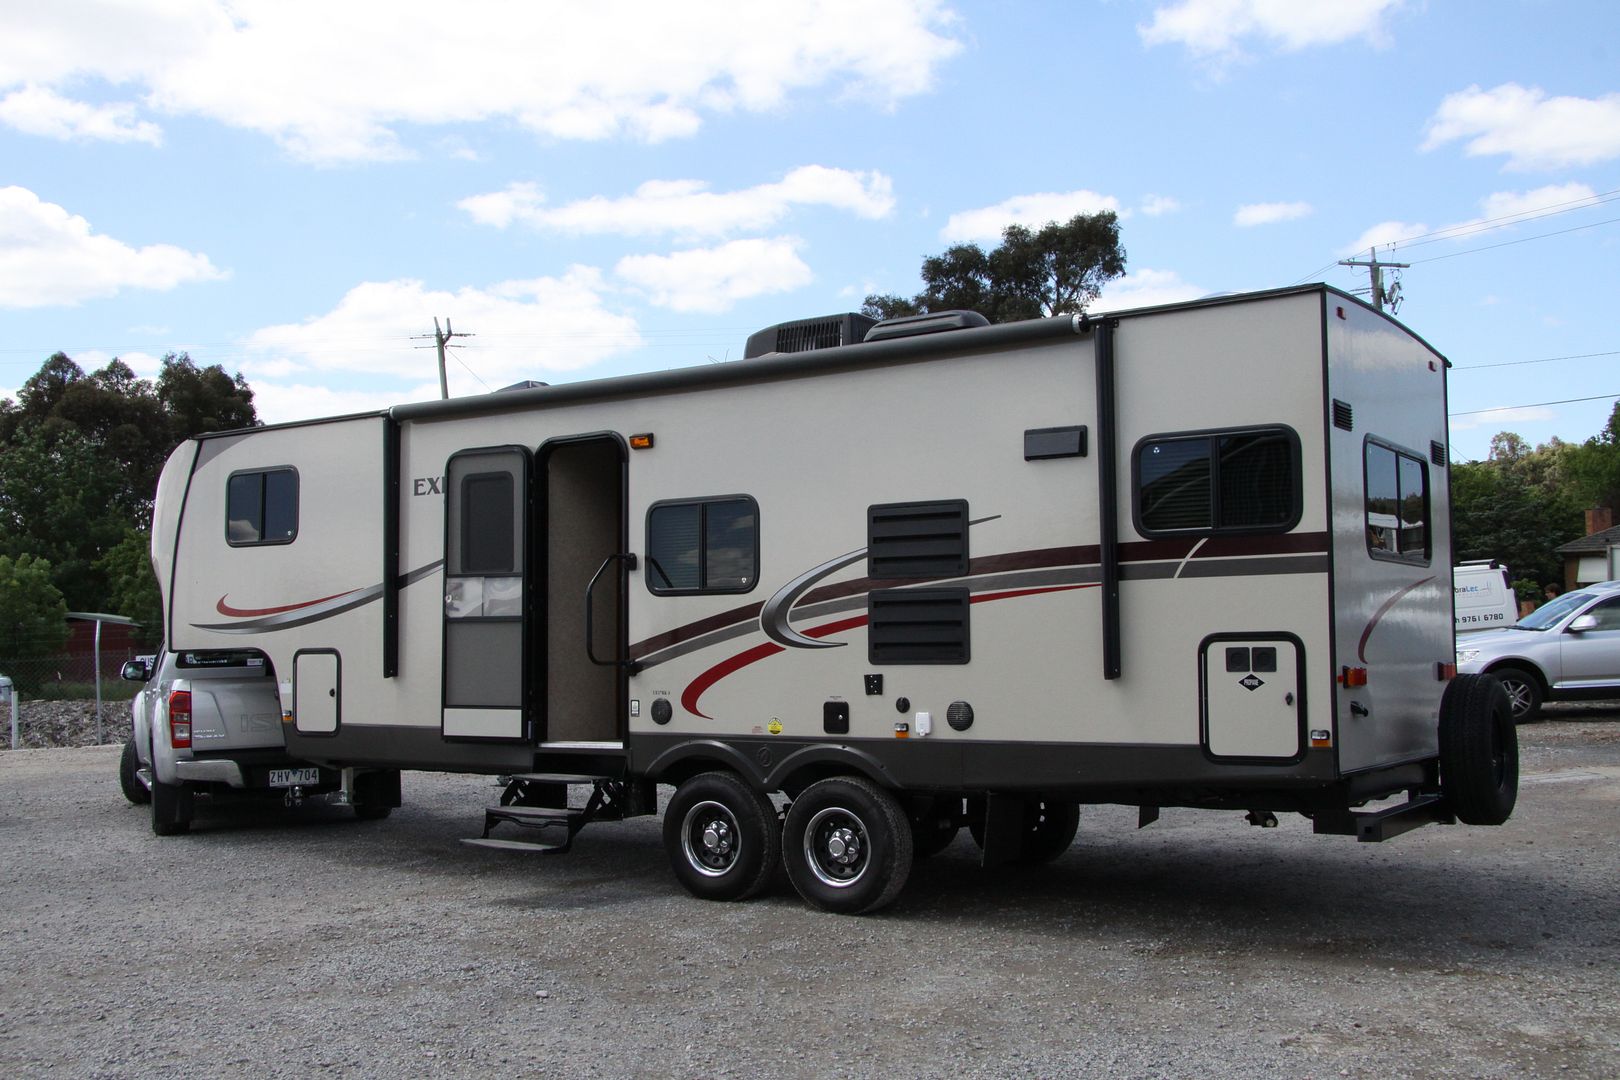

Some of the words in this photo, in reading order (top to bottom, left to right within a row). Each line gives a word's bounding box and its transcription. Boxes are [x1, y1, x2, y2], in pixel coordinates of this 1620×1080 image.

[1483, 613, 1504, 621] 6780
[270, 770, 290, 784] ZHV
[298, 769, 318, 782] 704
